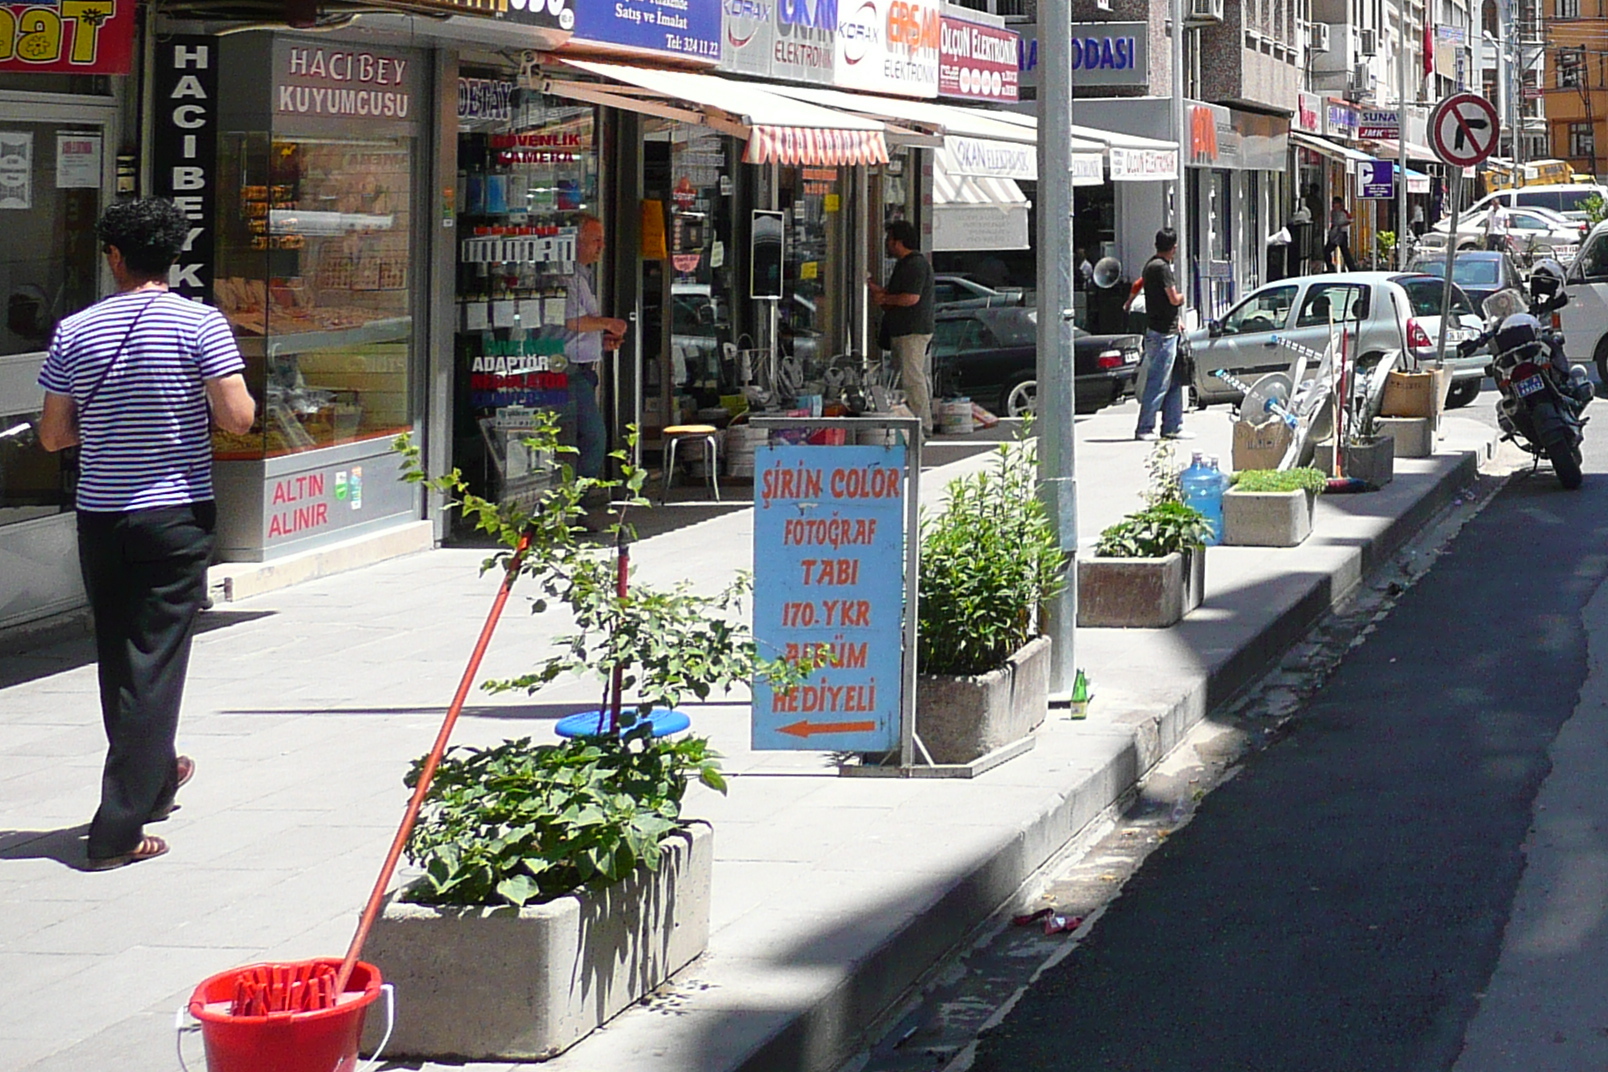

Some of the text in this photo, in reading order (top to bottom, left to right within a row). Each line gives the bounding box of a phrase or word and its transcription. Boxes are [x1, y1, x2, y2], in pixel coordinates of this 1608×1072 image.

[614, 3, 689, 30] Satış ve İmalat
[838, 19, 880, 44] KORAX
[665, 33, 719, 57] Tel: 324 11 22
[279, 85, 409, 118] KUYUMCUSU
[457, 77, 513, 121] DETAY
[1362, 112, 1399, 122] SUNA
[1360, 128, 1384, 138] JMK
[472, 354, 549, 372] ADAPTÖR
[272, 473, 325, 506] ALTIN
[761, 460, 901, 509] ŞİRİN COLOR
[268, 503, 328, 539] ALINIR
[783, 511, 878, 550] FOTOĞRAF
[801, 558, 859, 586] TABI
[771, 676, 876, 714] HEDİYELİ
